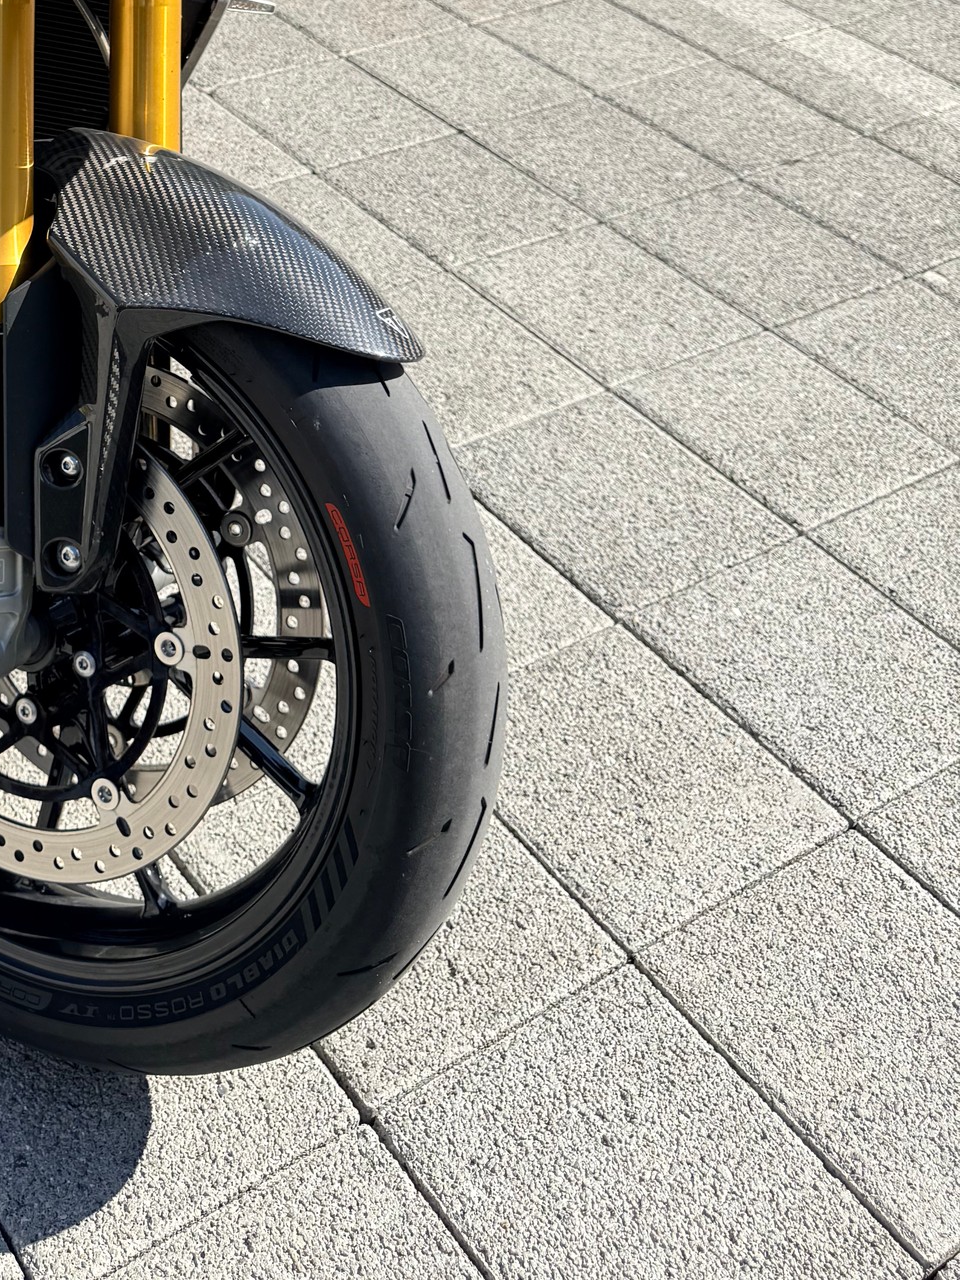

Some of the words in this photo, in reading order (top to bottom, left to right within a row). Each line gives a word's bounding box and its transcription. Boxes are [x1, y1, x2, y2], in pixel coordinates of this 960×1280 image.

[331, 509, 366, 598] CORSA
[209, 928, 300, 1001] DIABLO
[58, 1002, 99, 1018] IV
